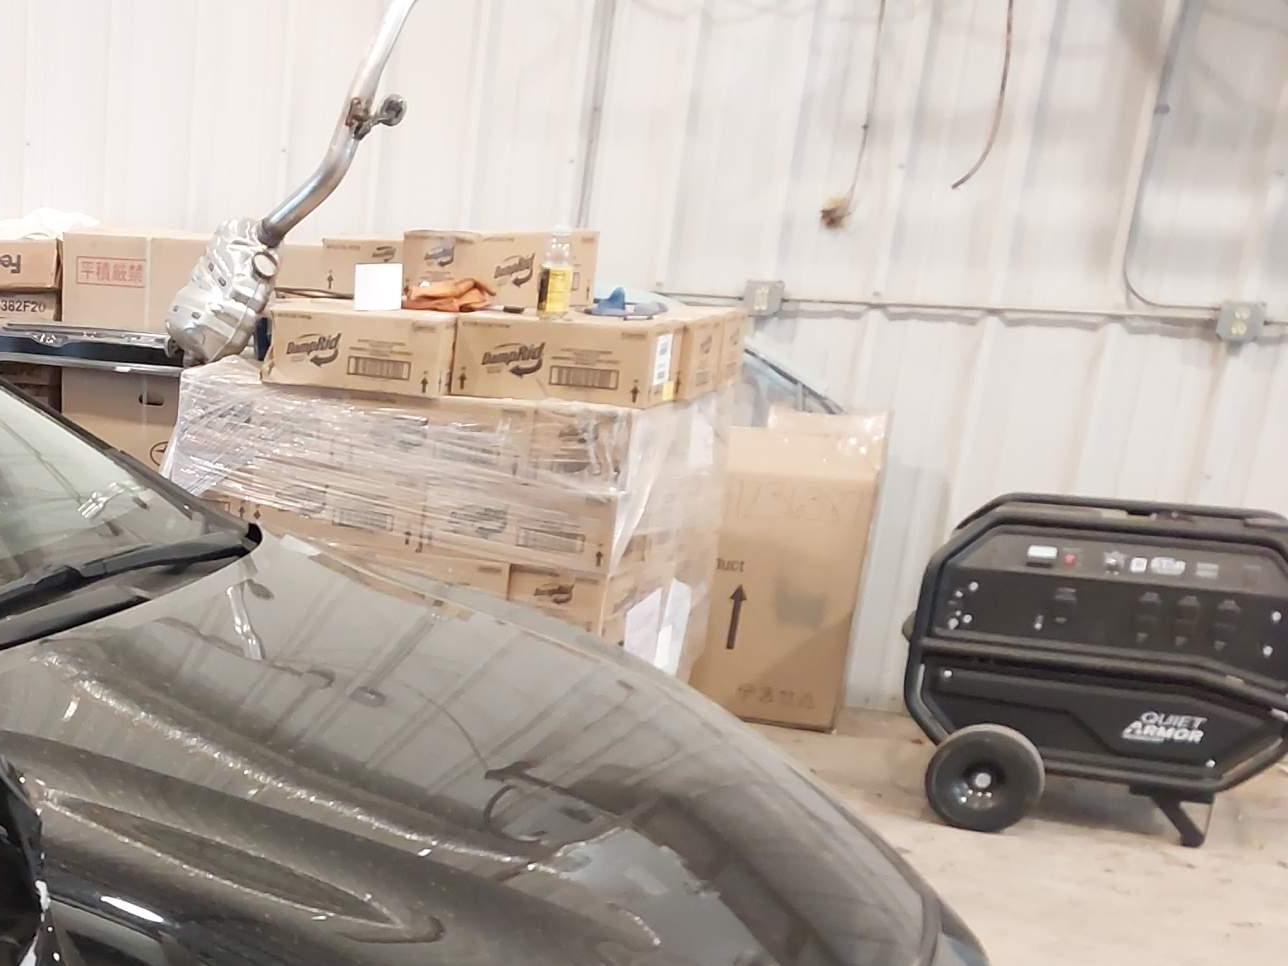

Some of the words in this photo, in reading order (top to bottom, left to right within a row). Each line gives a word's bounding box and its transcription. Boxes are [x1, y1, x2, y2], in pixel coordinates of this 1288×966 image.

[286, 332, 343, 357] DampRid
[481, 341, 546, 367] DampRid
[1121, 720, 1205, 744] ARMOR
[1140, 711, 1208, 729] QUIET
